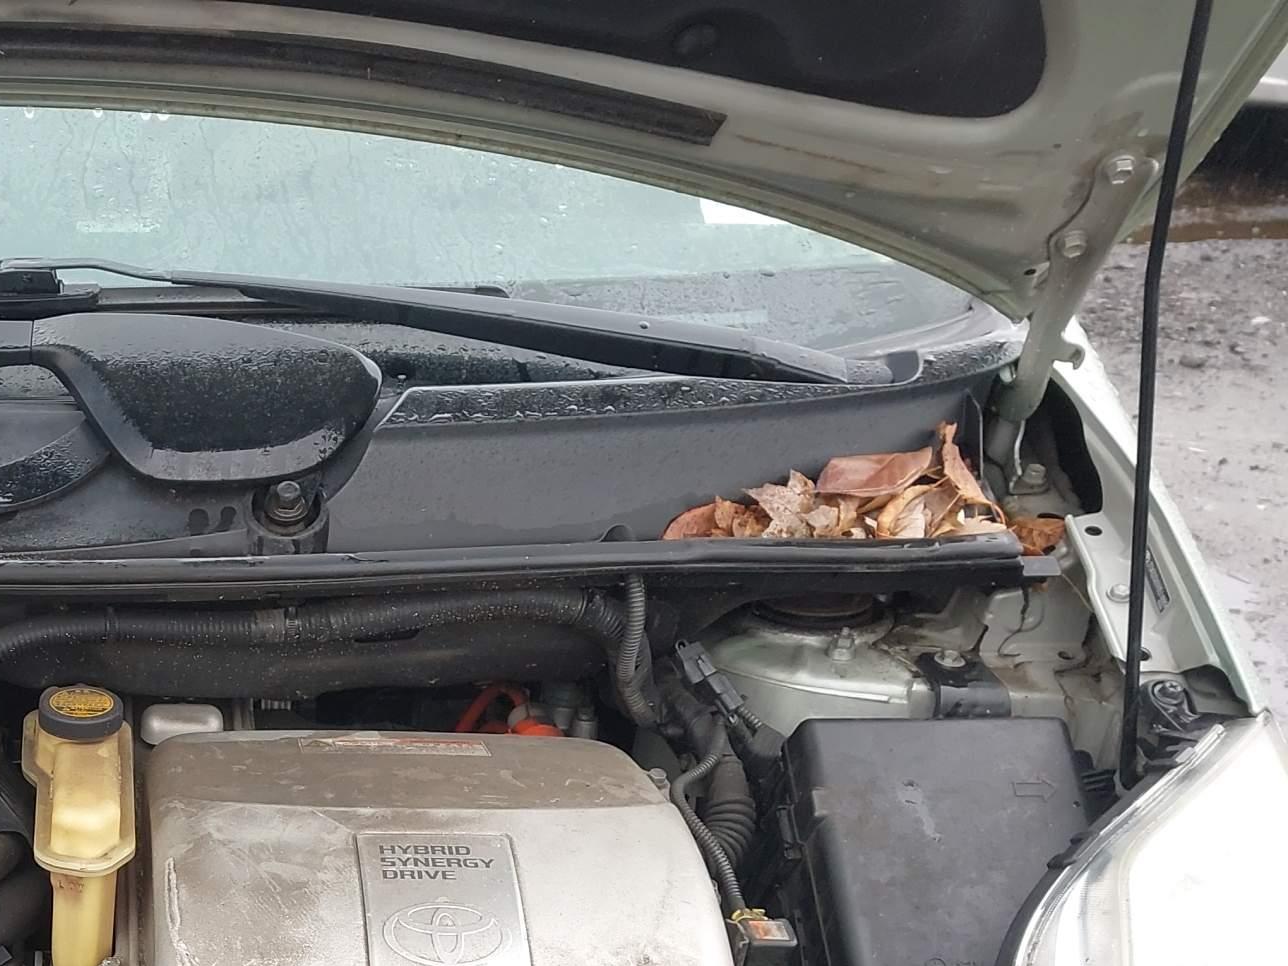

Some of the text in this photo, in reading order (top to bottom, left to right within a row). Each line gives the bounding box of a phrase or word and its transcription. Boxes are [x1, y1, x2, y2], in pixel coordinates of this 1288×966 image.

[379, 845, 471, 856] HYBRID
[380, 857, 495, 869] SYNERGY
[382, 869, 457, 880] DRIVE
